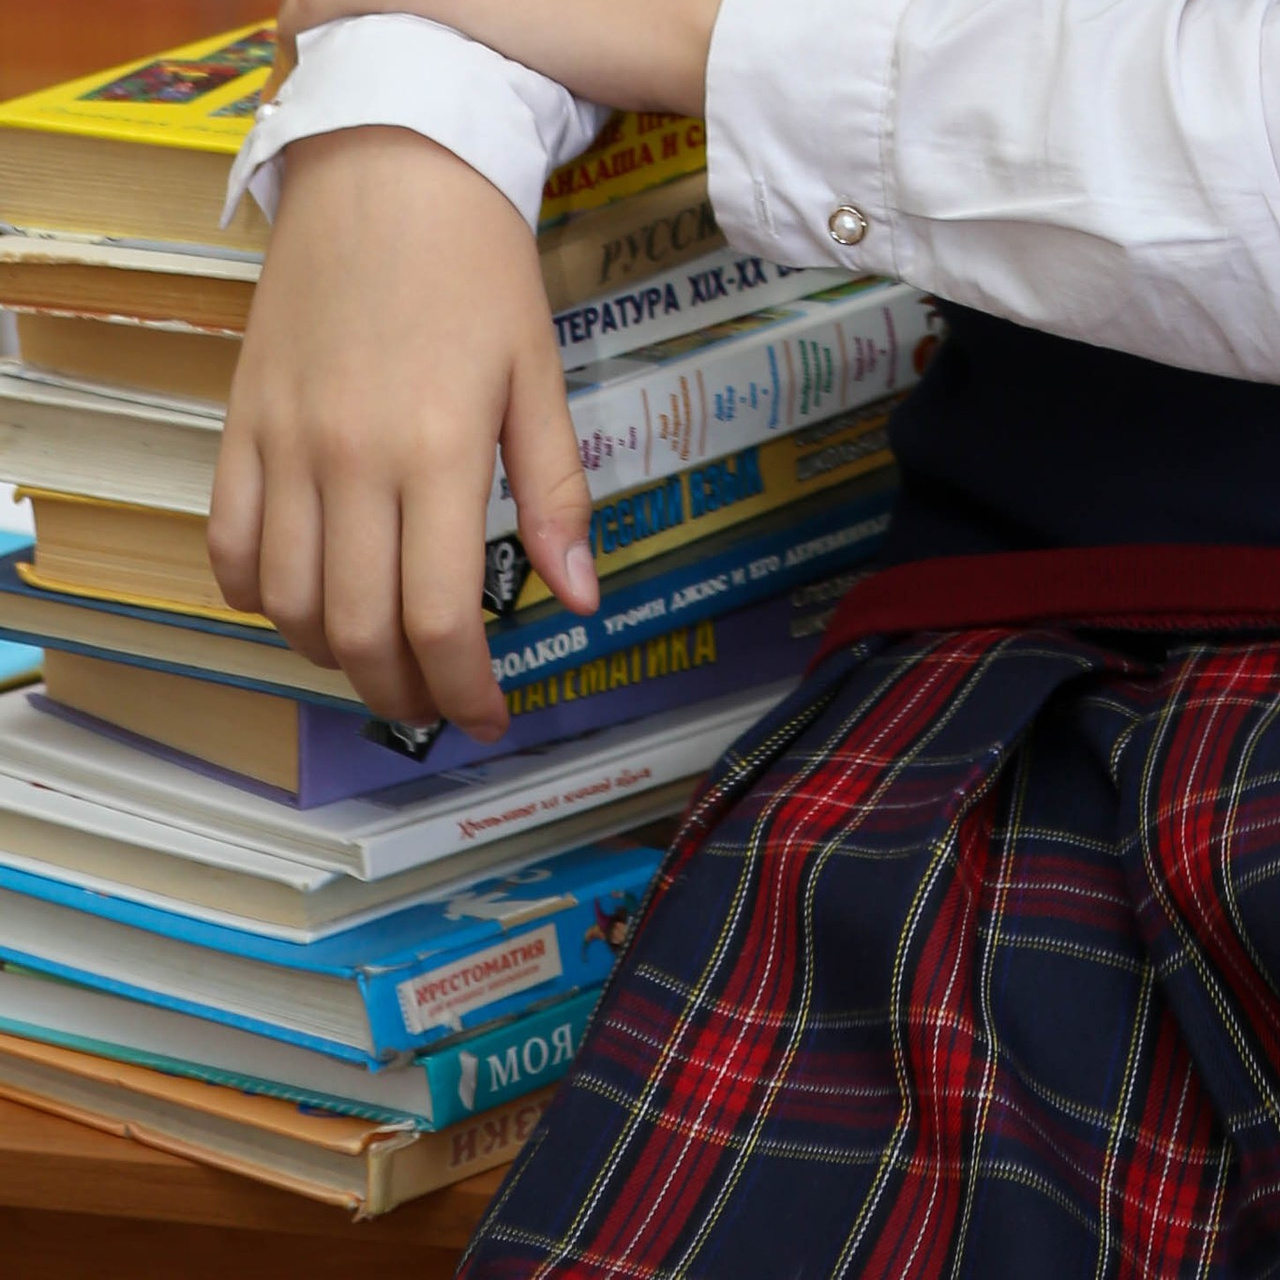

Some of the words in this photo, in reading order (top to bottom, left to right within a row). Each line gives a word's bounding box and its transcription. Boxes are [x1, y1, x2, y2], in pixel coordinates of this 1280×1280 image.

[545, 143, 654, 200] АНДАША
[600, 201, 718, 283] РУССК
[553, 283, 679, 346] ТЕРАТУРА
[588, 474, 684, 559] УССКИЙ
[690, 445, 764, 519] ЯЗЫК
[750, 556, 780, 580] ЕГО
[416, 938, 546, 1007] ХРЕСТОМАТИЯ
[488, 1023, 576, 1091] МОЯ
